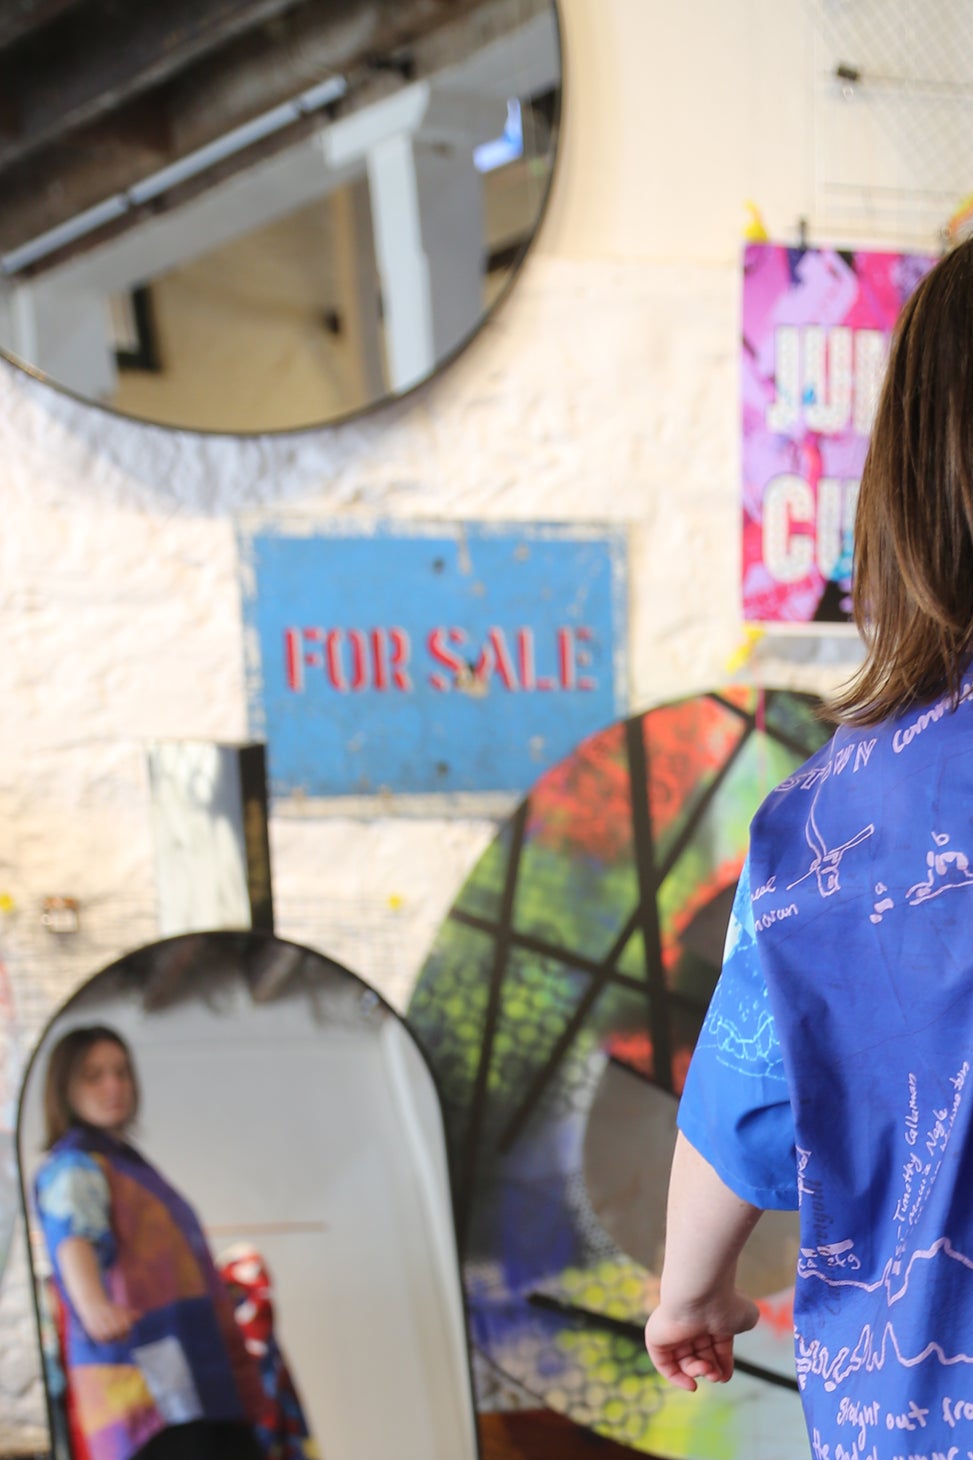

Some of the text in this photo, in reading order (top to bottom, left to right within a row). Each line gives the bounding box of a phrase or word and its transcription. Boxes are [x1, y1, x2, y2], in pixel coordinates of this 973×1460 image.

[763, 473, 858, 583] CU
[284, 626, 599, 698] FOR SALE
[886, 1401, 929, 1431] out
